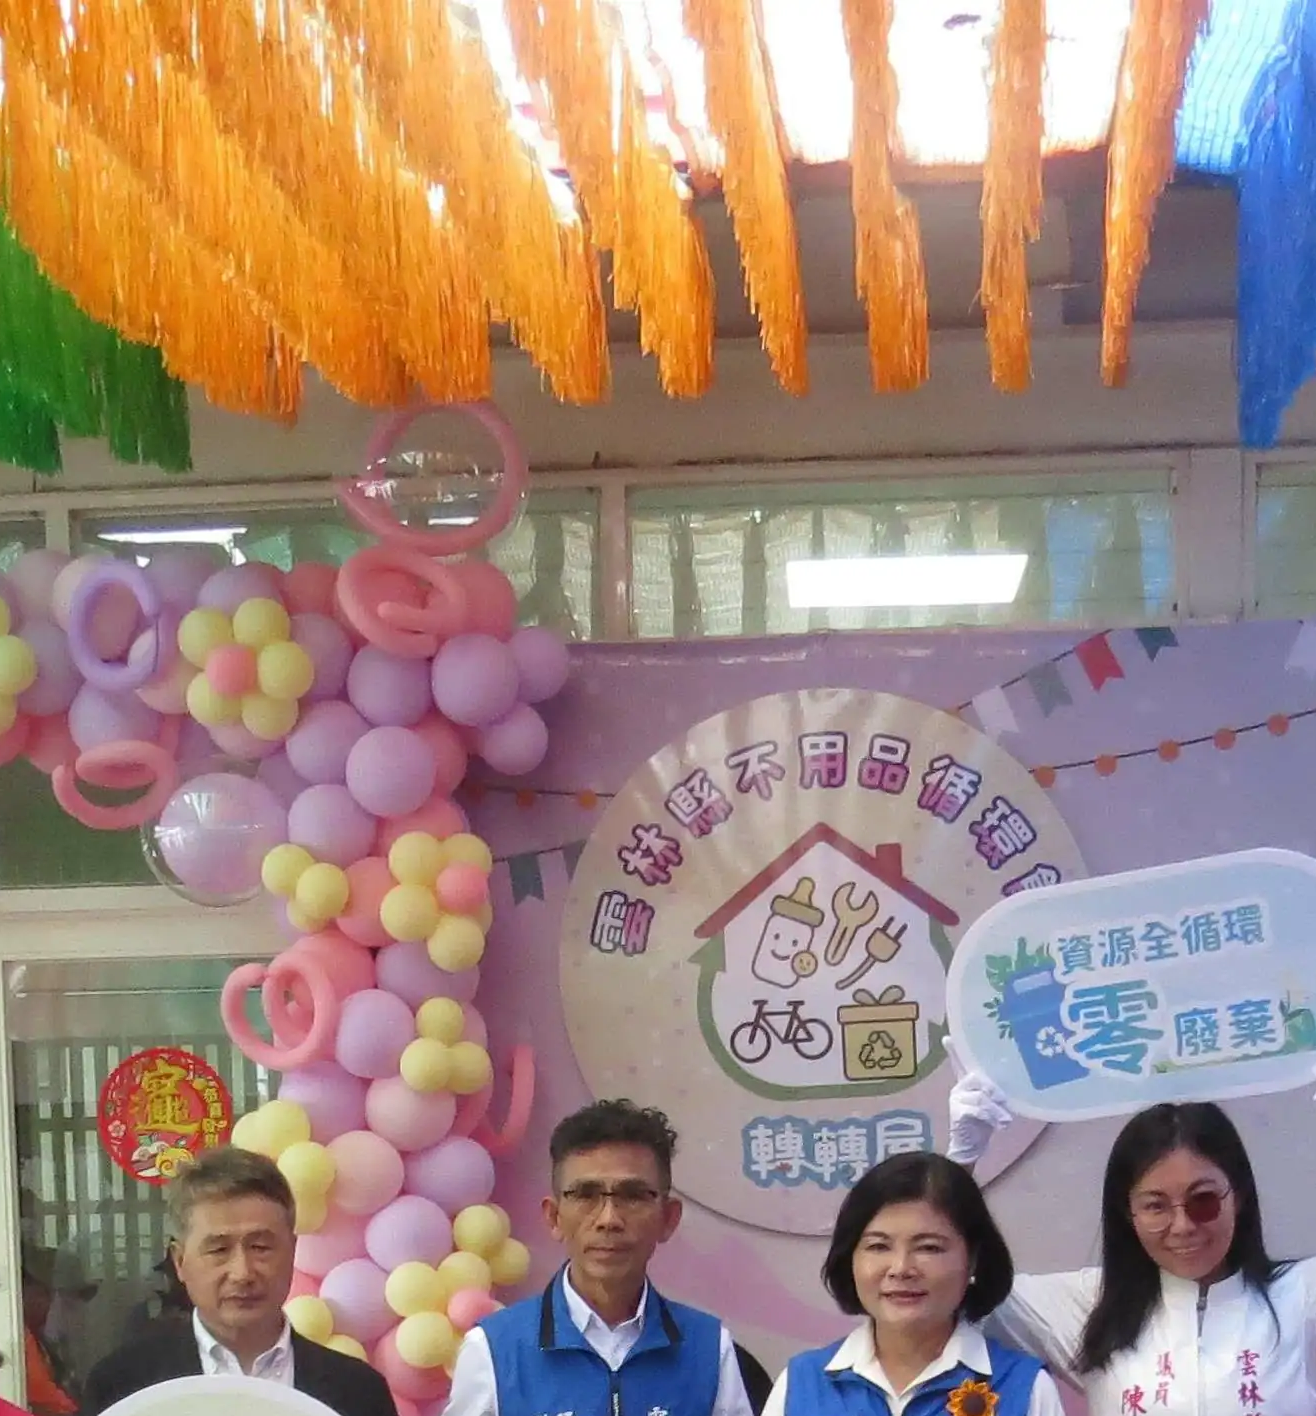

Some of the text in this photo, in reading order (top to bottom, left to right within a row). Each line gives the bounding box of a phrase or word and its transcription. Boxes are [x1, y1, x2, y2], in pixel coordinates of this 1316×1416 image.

[1056, 903, 1266, 976] 資源全循環
[1067, 979, 1277, 1076] 零廢棄
